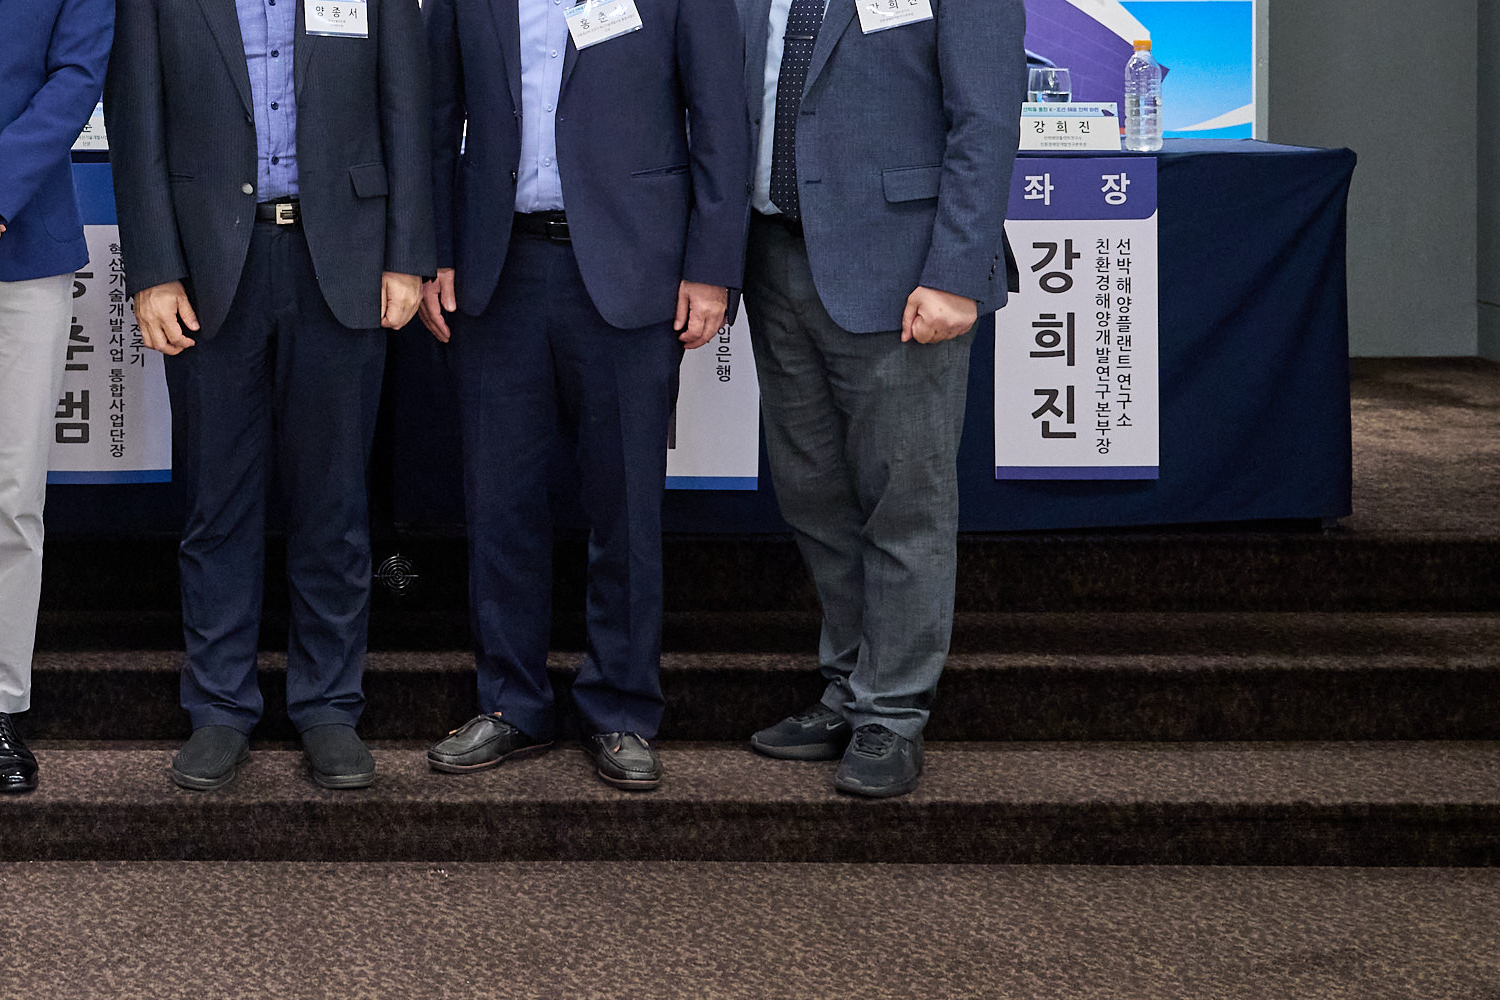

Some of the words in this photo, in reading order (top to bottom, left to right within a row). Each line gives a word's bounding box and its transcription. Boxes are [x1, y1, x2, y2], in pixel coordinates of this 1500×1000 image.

[109, 369, 125, 459] 통합사업단장
[1029, 239, 1081, 440] 강희진
[1095, 238, 1111, 455] 친환경해양개발연구본부장
[1115, 238, 1132, 428] 선박해양플랜트연구소
